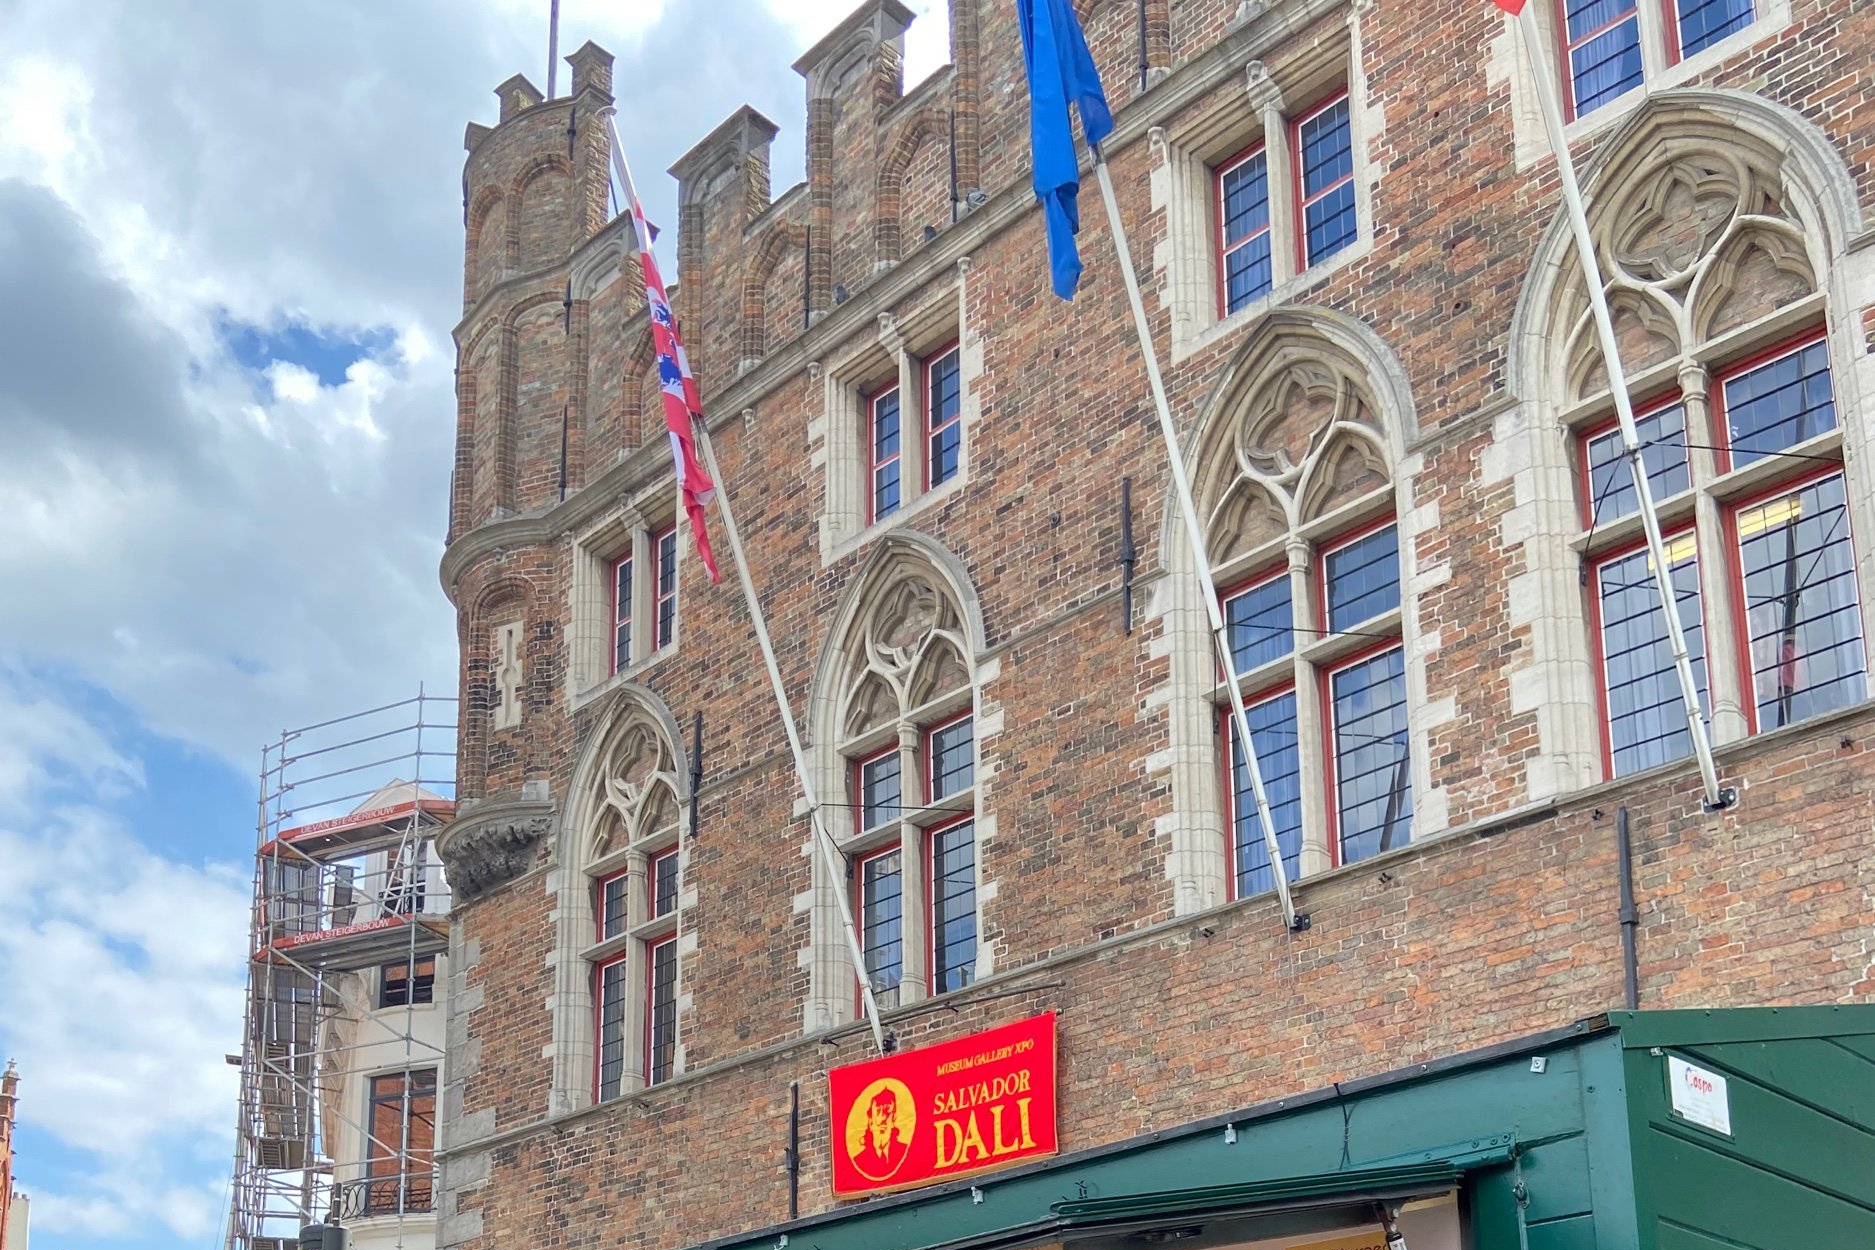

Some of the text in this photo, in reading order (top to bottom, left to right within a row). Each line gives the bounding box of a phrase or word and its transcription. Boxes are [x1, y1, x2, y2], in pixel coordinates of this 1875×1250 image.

[301, 806, 395, 834] DEVAN STEIGERBOUW
[294, 919, 390, 944] DEVAN STEIGERBOUW
[937, 1038, 1035, 1077] MUSEUM GALLERY XPO
[933, 1069, 1031, 1115] SALVADOR
[933, 1097, 1037, 1169] DALI
